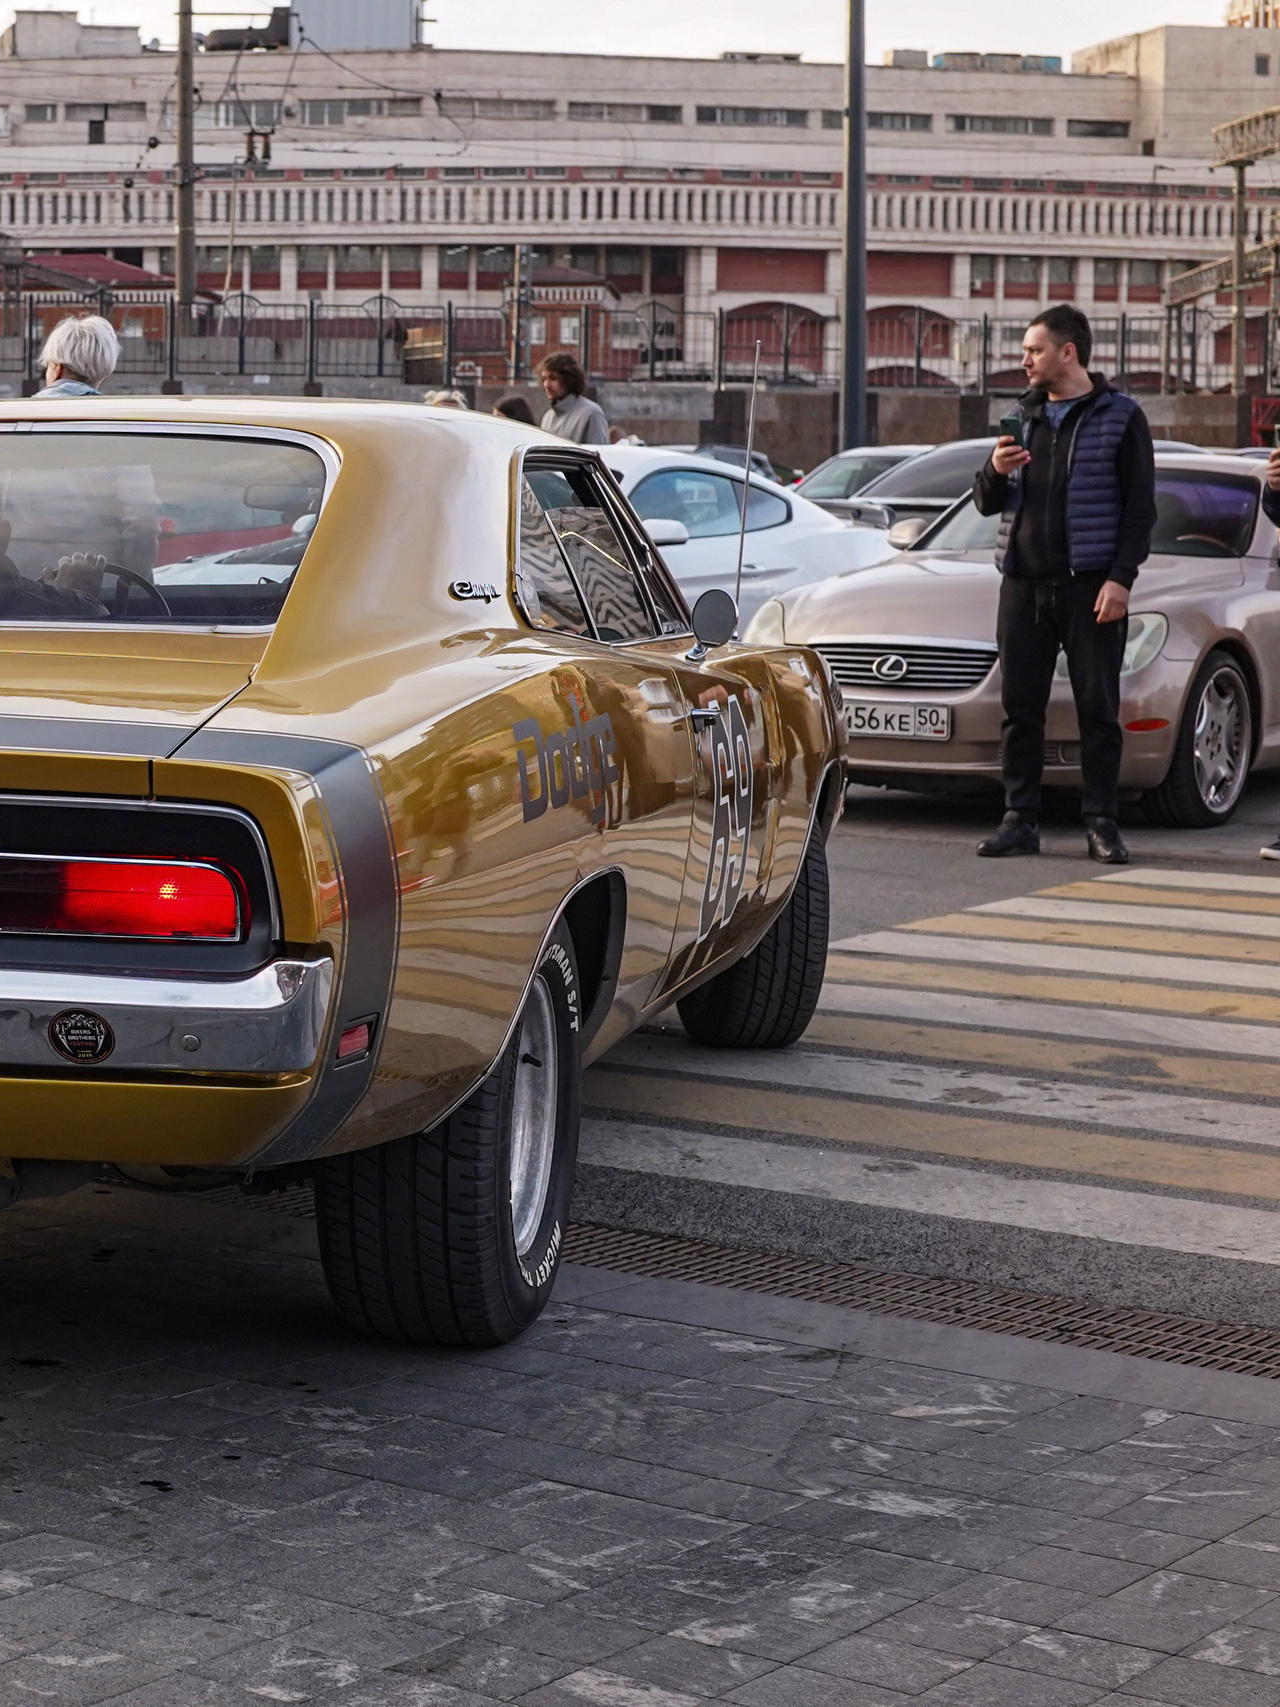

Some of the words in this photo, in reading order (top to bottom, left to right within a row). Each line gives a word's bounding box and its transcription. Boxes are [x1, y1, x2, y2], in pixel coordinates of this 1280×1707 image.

[918, 709, 939, 726] 50
[512, 694, 619, 826] Dodge
[535, 1220, 562, 1287] MICKEY
